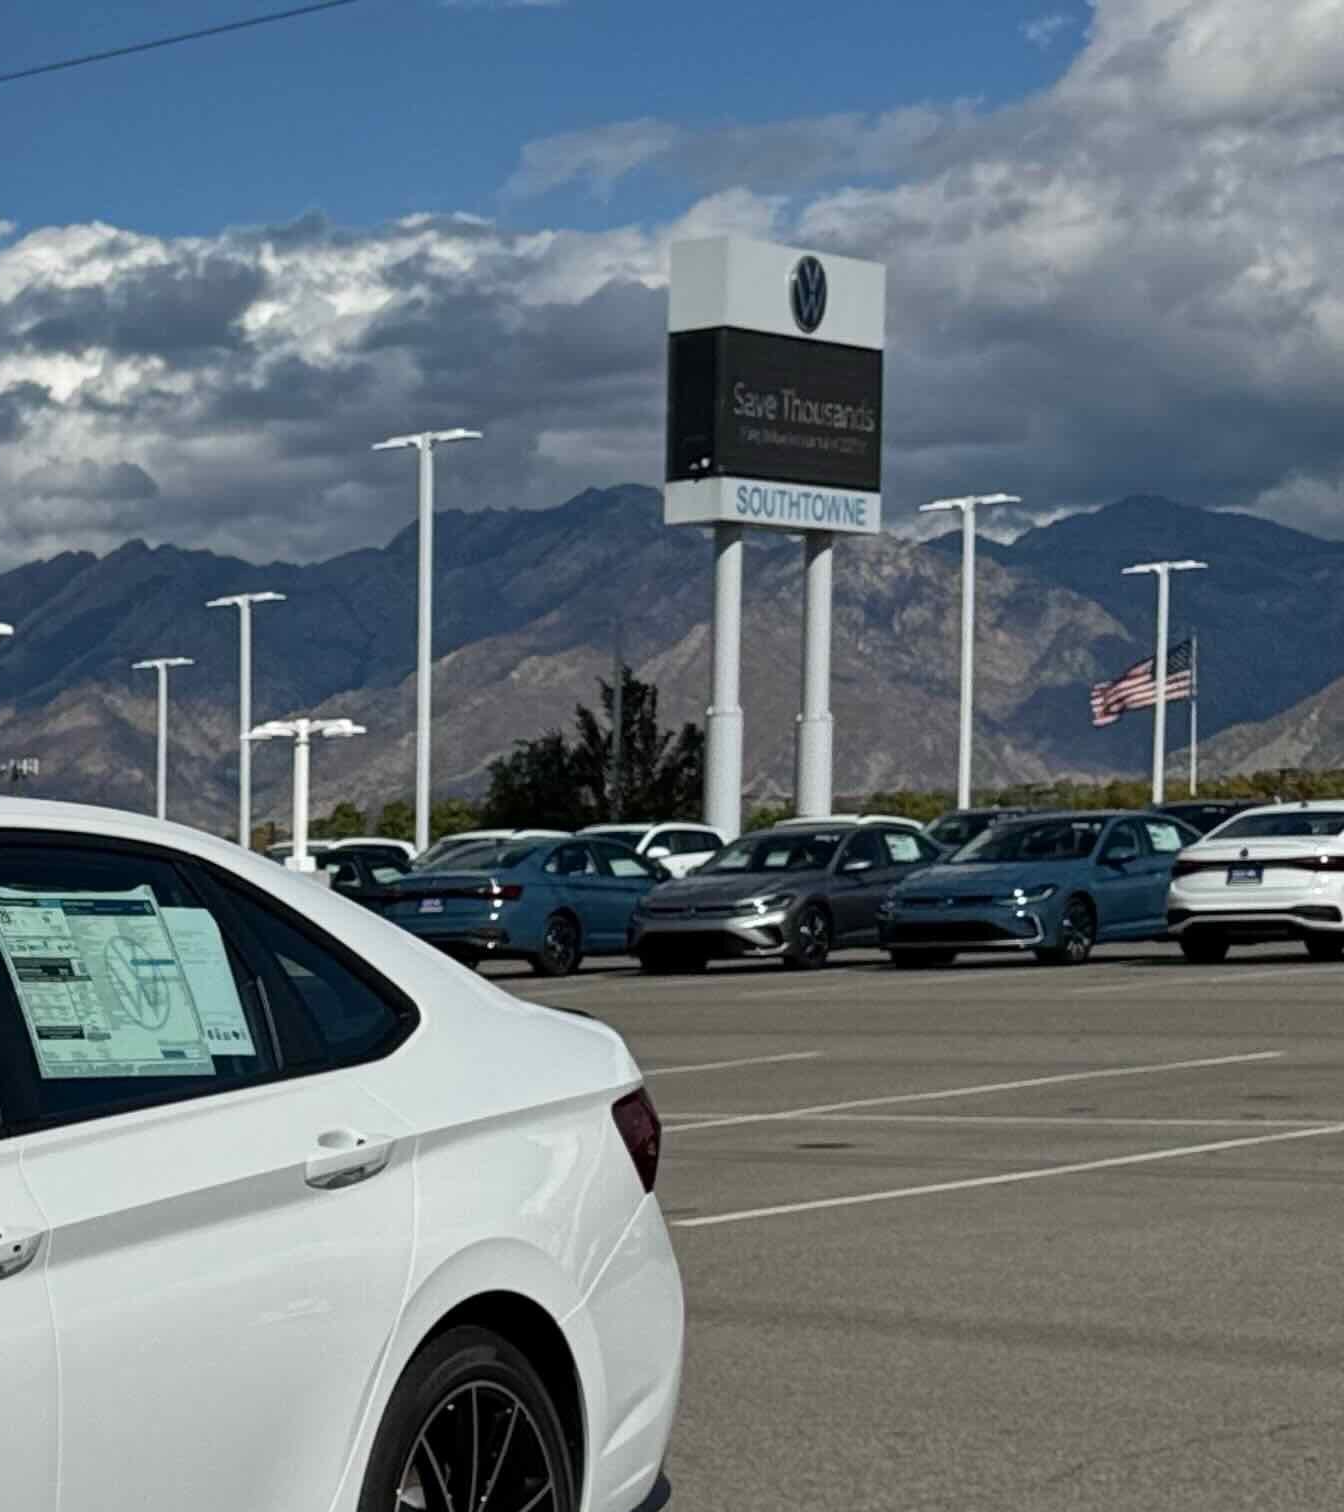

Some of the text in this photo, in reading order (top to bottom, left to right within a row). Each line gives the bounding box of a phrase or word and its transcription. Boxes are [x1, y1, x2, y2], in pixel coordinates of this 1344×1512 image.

[733, 381, 876, 433] Save Thousands
[735, 484, 868, 526] SOUTHTOWNE
